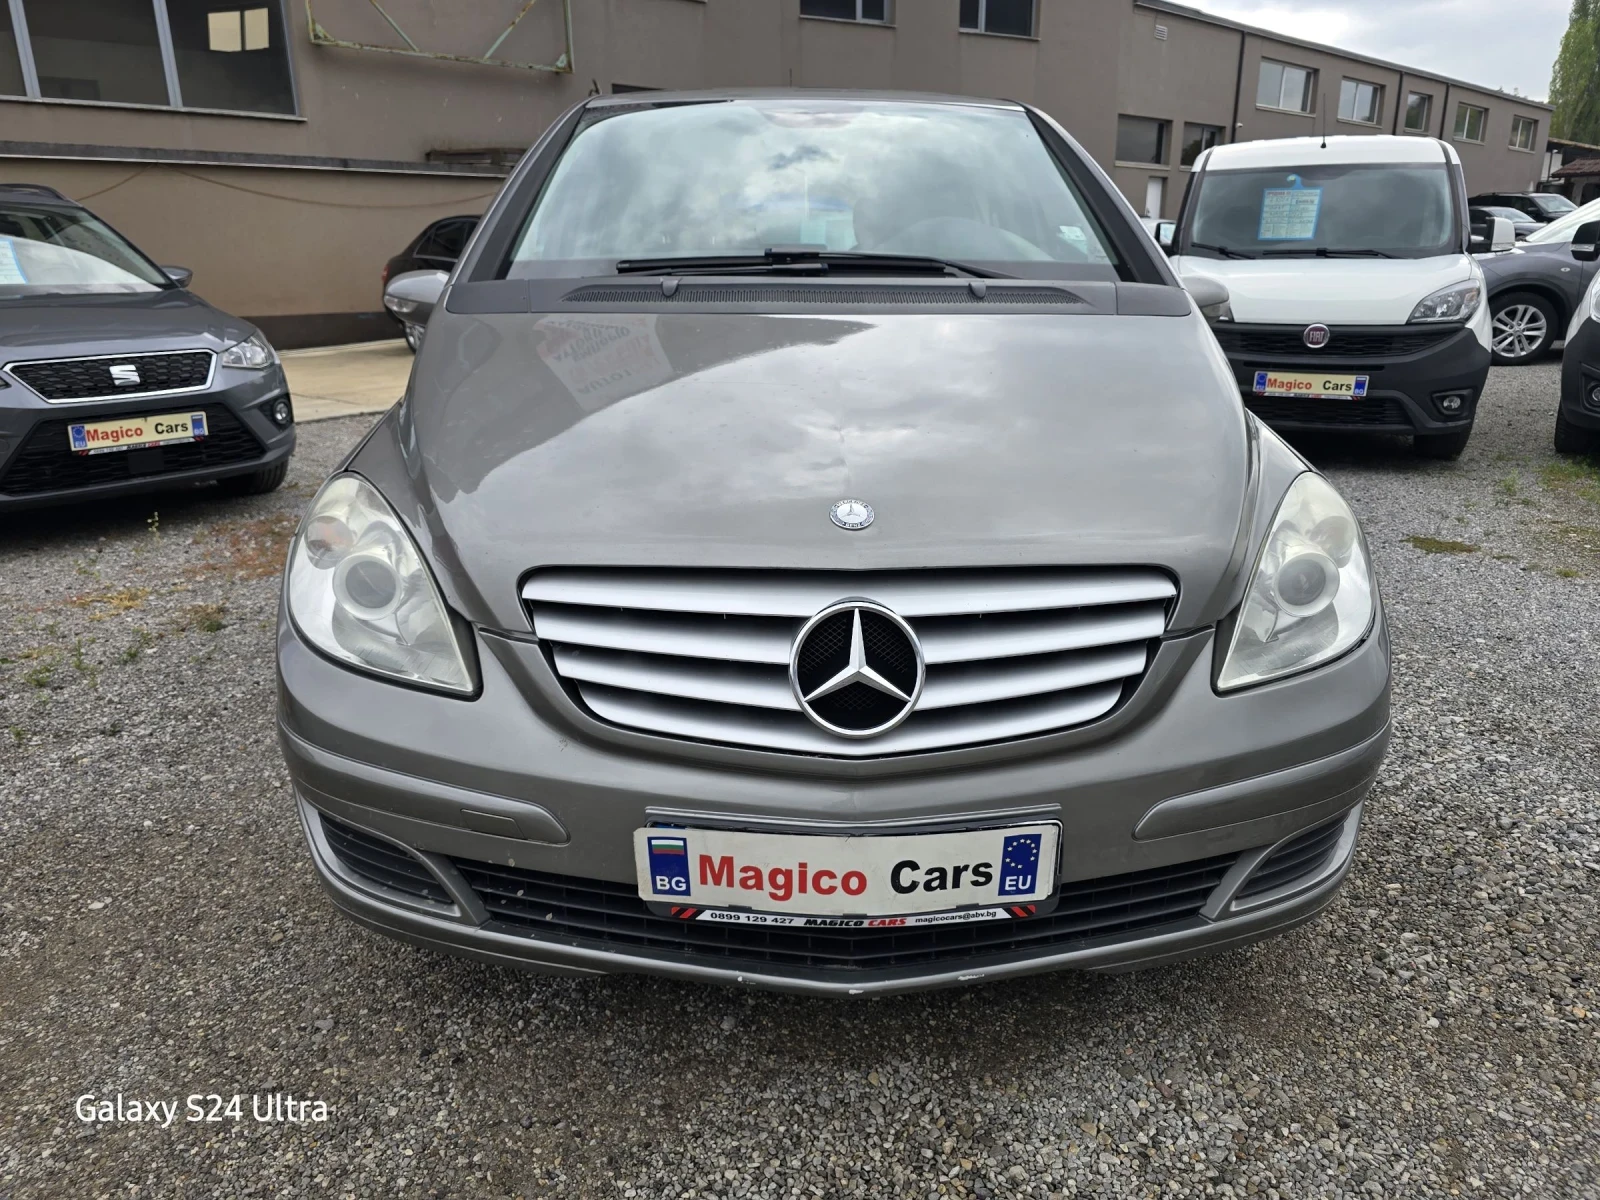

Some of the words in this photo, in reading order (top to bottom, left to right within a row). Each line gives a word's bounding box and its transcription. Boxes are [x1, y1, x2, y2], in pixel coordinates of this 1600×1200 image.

[1309, 331, 1324, 342] FIAT
[1266, 378, 1312, 391] Magico
[1322, 380, 1352, 391] Cars
[86, 426, 143, 443] Magico
[154, 422, 189, 435] Cars
[656, 875, 687, 891] BG
[699, 854, 868, 901] Magico
[890, 859, 993, 895] Cars
[1004, 875, 1032, 891] EU
[710, 912, 741, 921] 0899
[745, 915, 767, 923] 129
[771, 917, 795, 925] 427
[803, 918, 864, 927] MAGICO
[868, 918, 908, 927] CARS
[915, 910, 997, 923] magicocars@abv.bg
